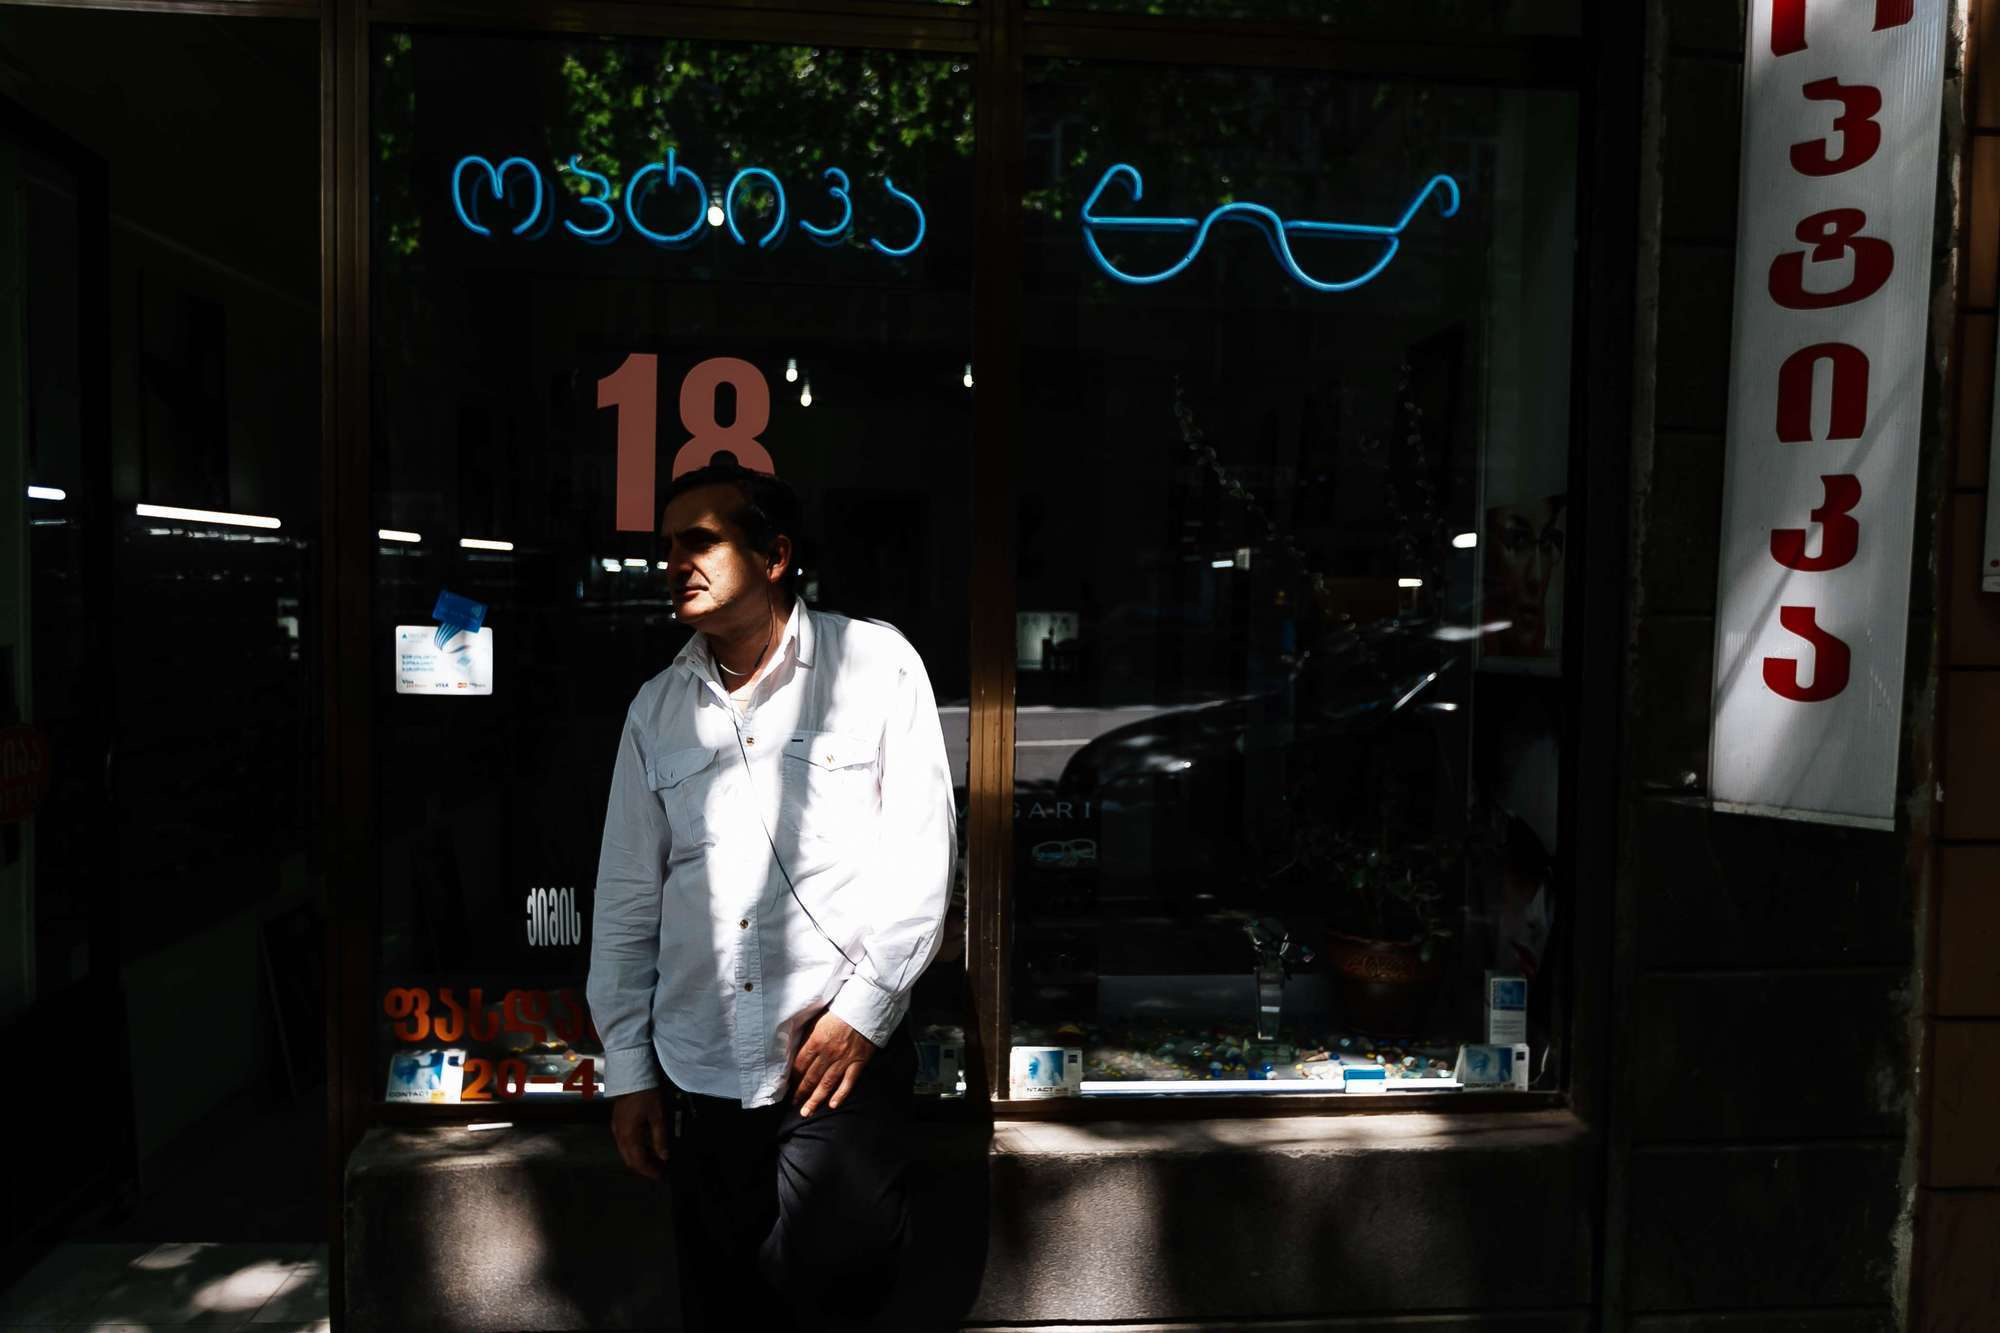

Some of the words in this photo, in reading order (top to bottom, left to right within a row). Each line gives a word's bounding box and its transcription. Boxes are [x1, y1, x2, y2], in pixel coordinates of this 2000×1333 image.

[452, 147, 926, 256] ოპტიკა
[597, 353, 775, 532] 18
[383, 985, 598, 1043] ფასდა
